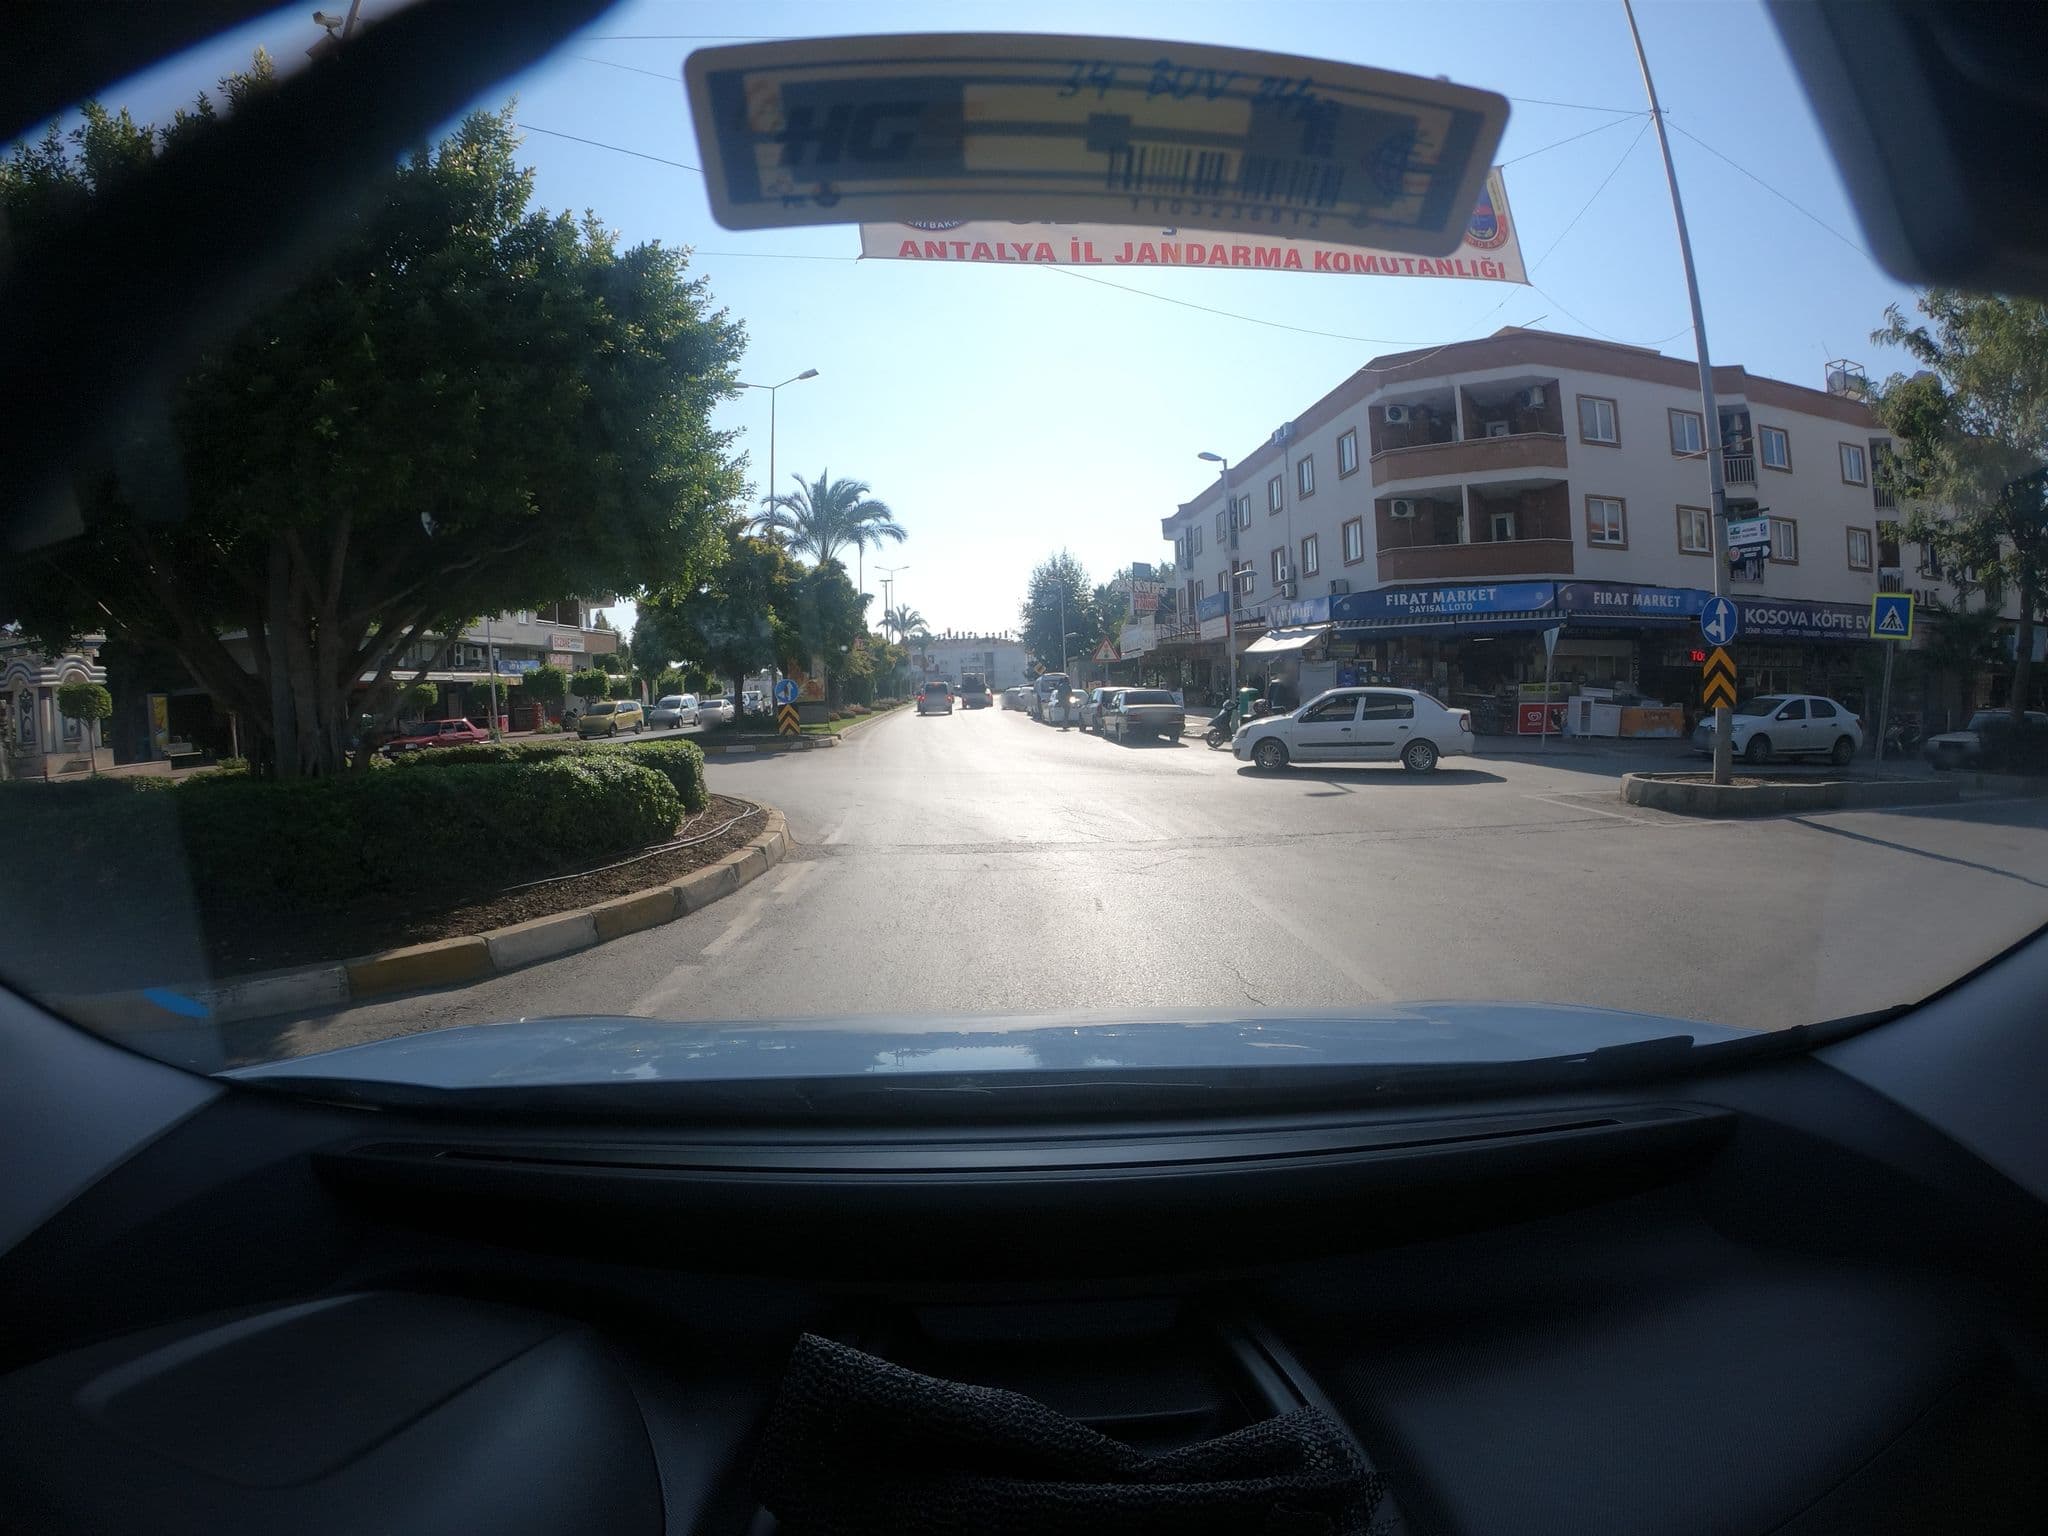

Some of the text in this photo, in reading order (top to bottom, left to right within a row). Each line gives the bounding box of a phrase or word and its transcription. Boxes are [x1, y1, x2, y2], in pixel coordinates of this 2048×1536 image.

[899, 236, 1506, 279] ANTALYA İL JANDARMA KOMUTANLIĞI
[1386, 588, 1497, 606] FIRAT MARKET
[1593, 591, 1681, 608] FIRAT MARKET
[1408, 602, 1473, 614] SAYISAL LOTO
[1745, 608, 1808, 627] KOSOVA
[1811, 609, 1853, 629] KÖFTE
